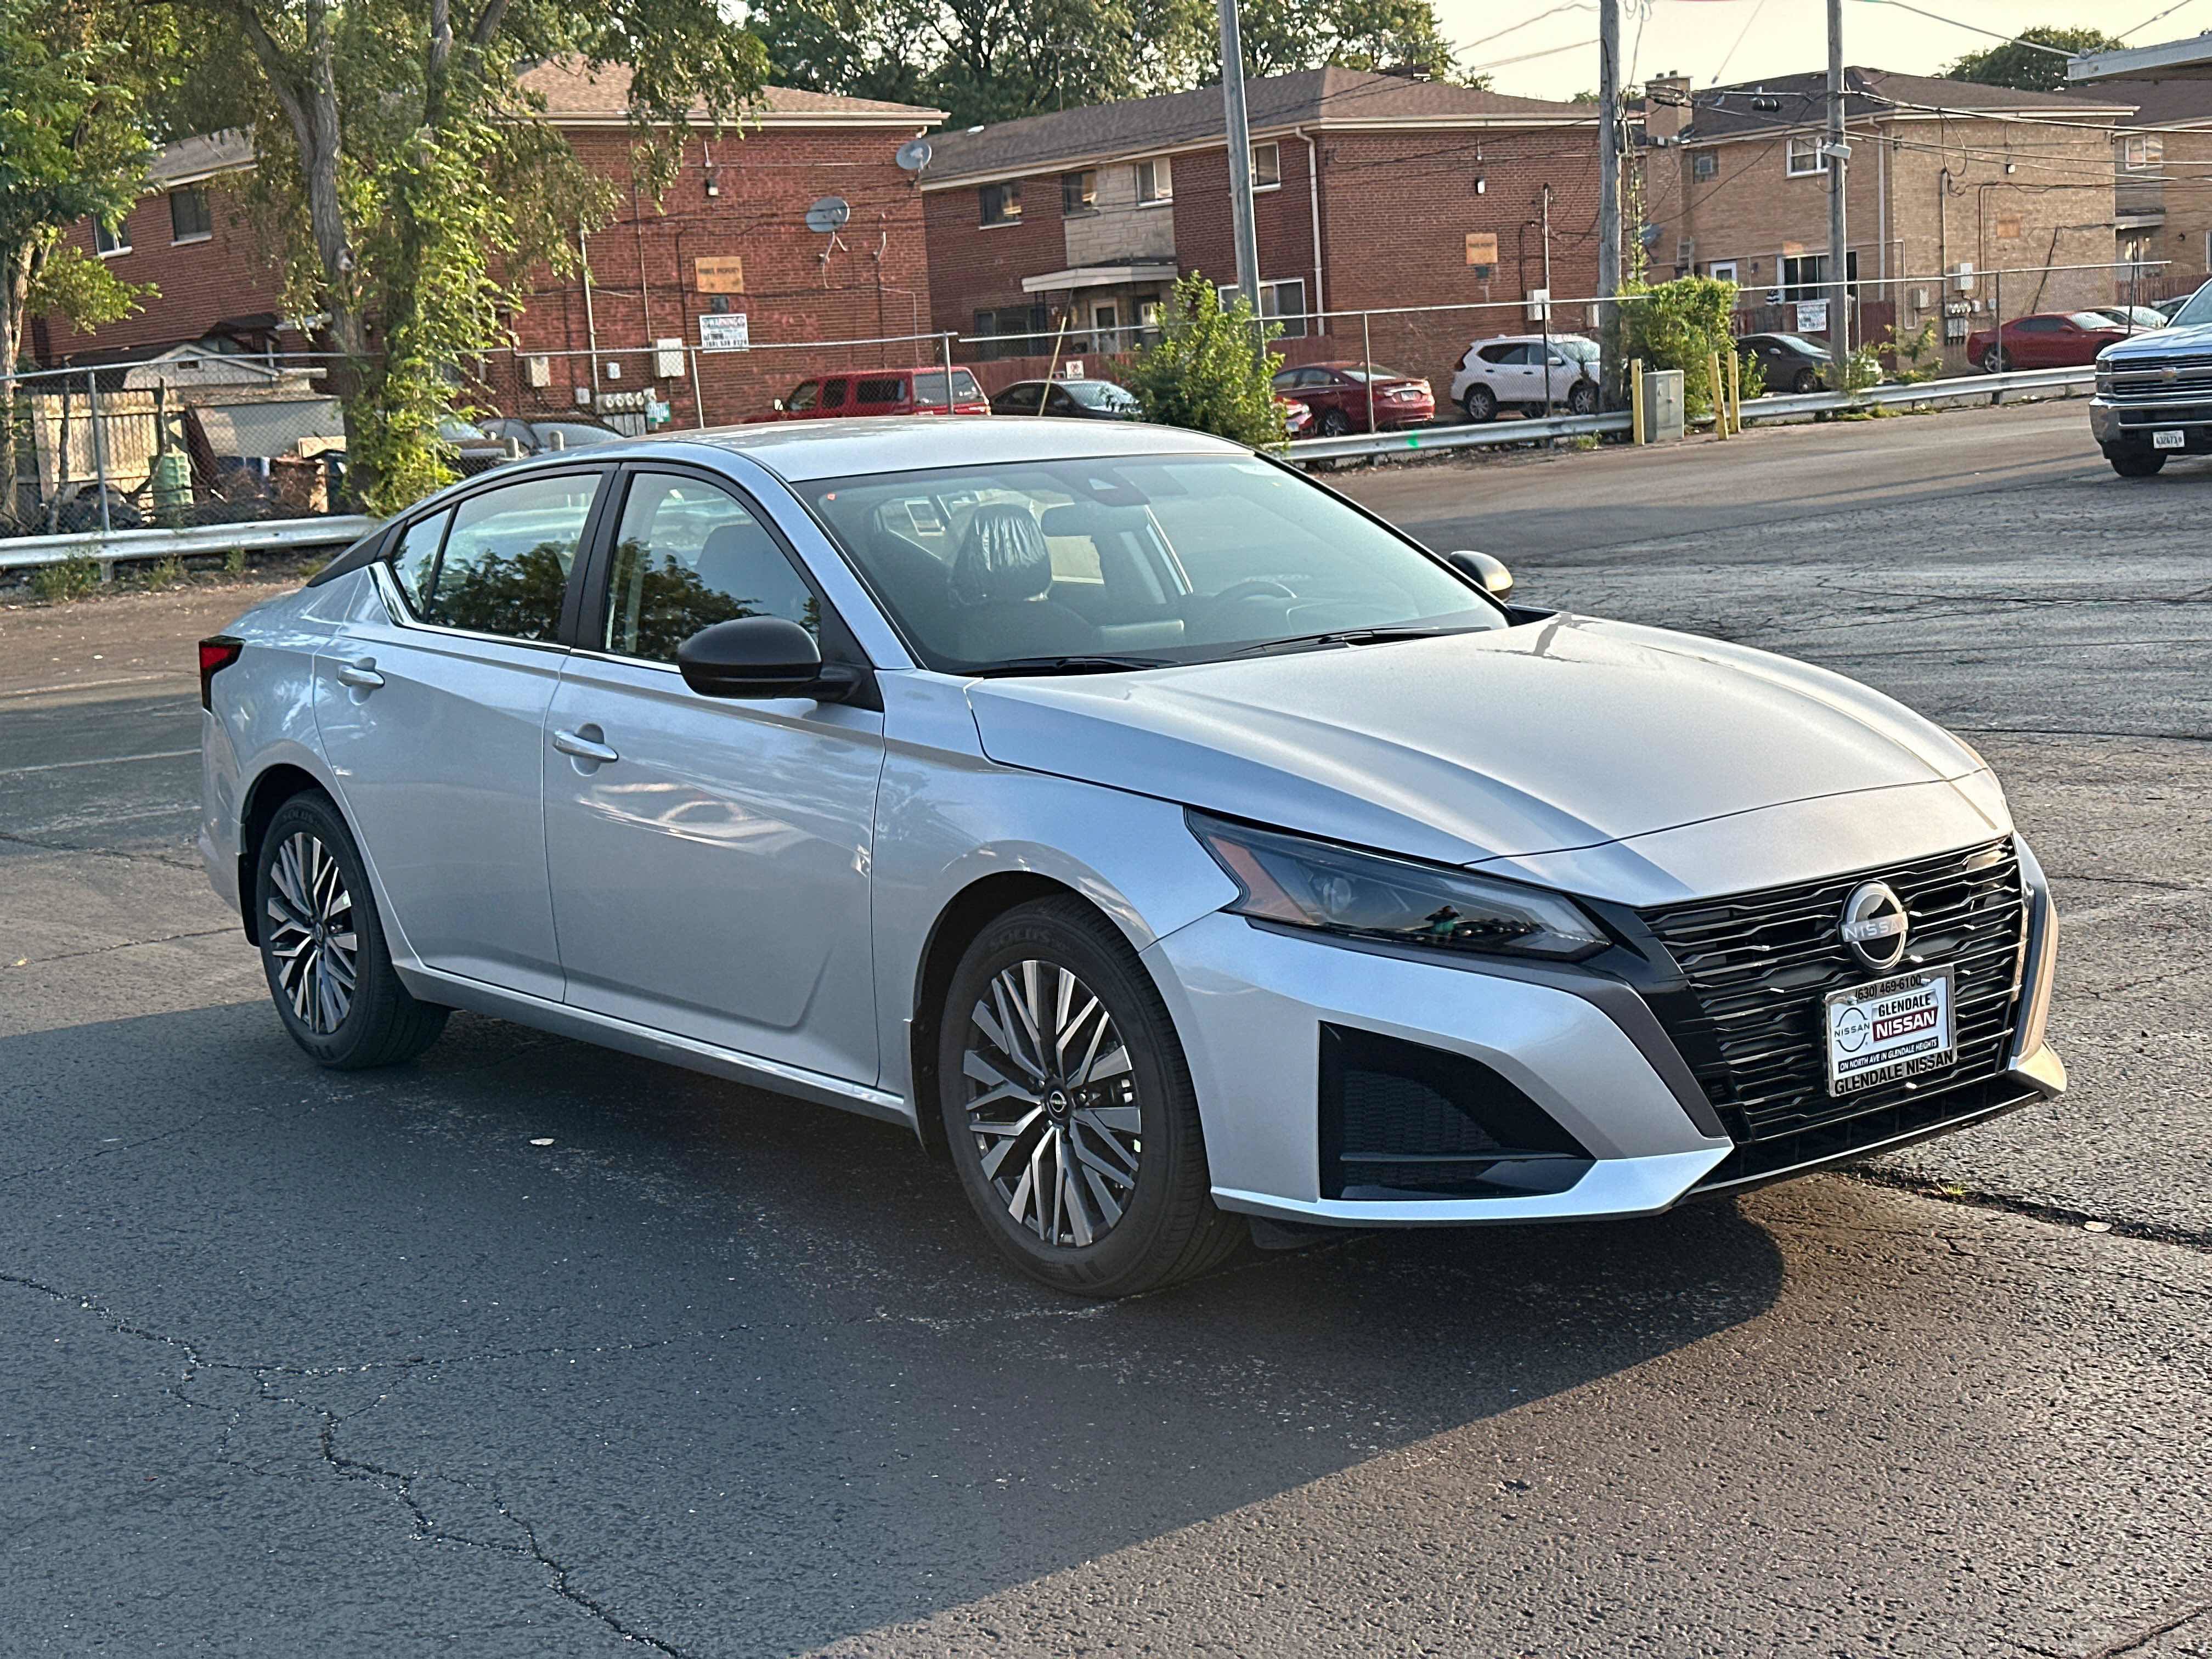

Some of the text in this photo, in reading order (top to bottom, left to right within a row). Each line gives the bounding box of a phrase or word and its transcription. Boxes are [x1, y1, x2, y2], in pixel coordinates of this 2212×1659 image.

[1855, 974, 1921, 1000] (630) 469-6100
[1878, 993, 1931, 1017] GLENDALE
[1834, 1022, 1870, 1038] NISSAN
[1876, 1010, 1935, 1039] NISSAN
[1840, 1039, 1938, 1071] ON NORTH AVE IN GLENDALE HEIGHTS
[1835, 1049, 1953, 1094] GLENDALE NISSAN
